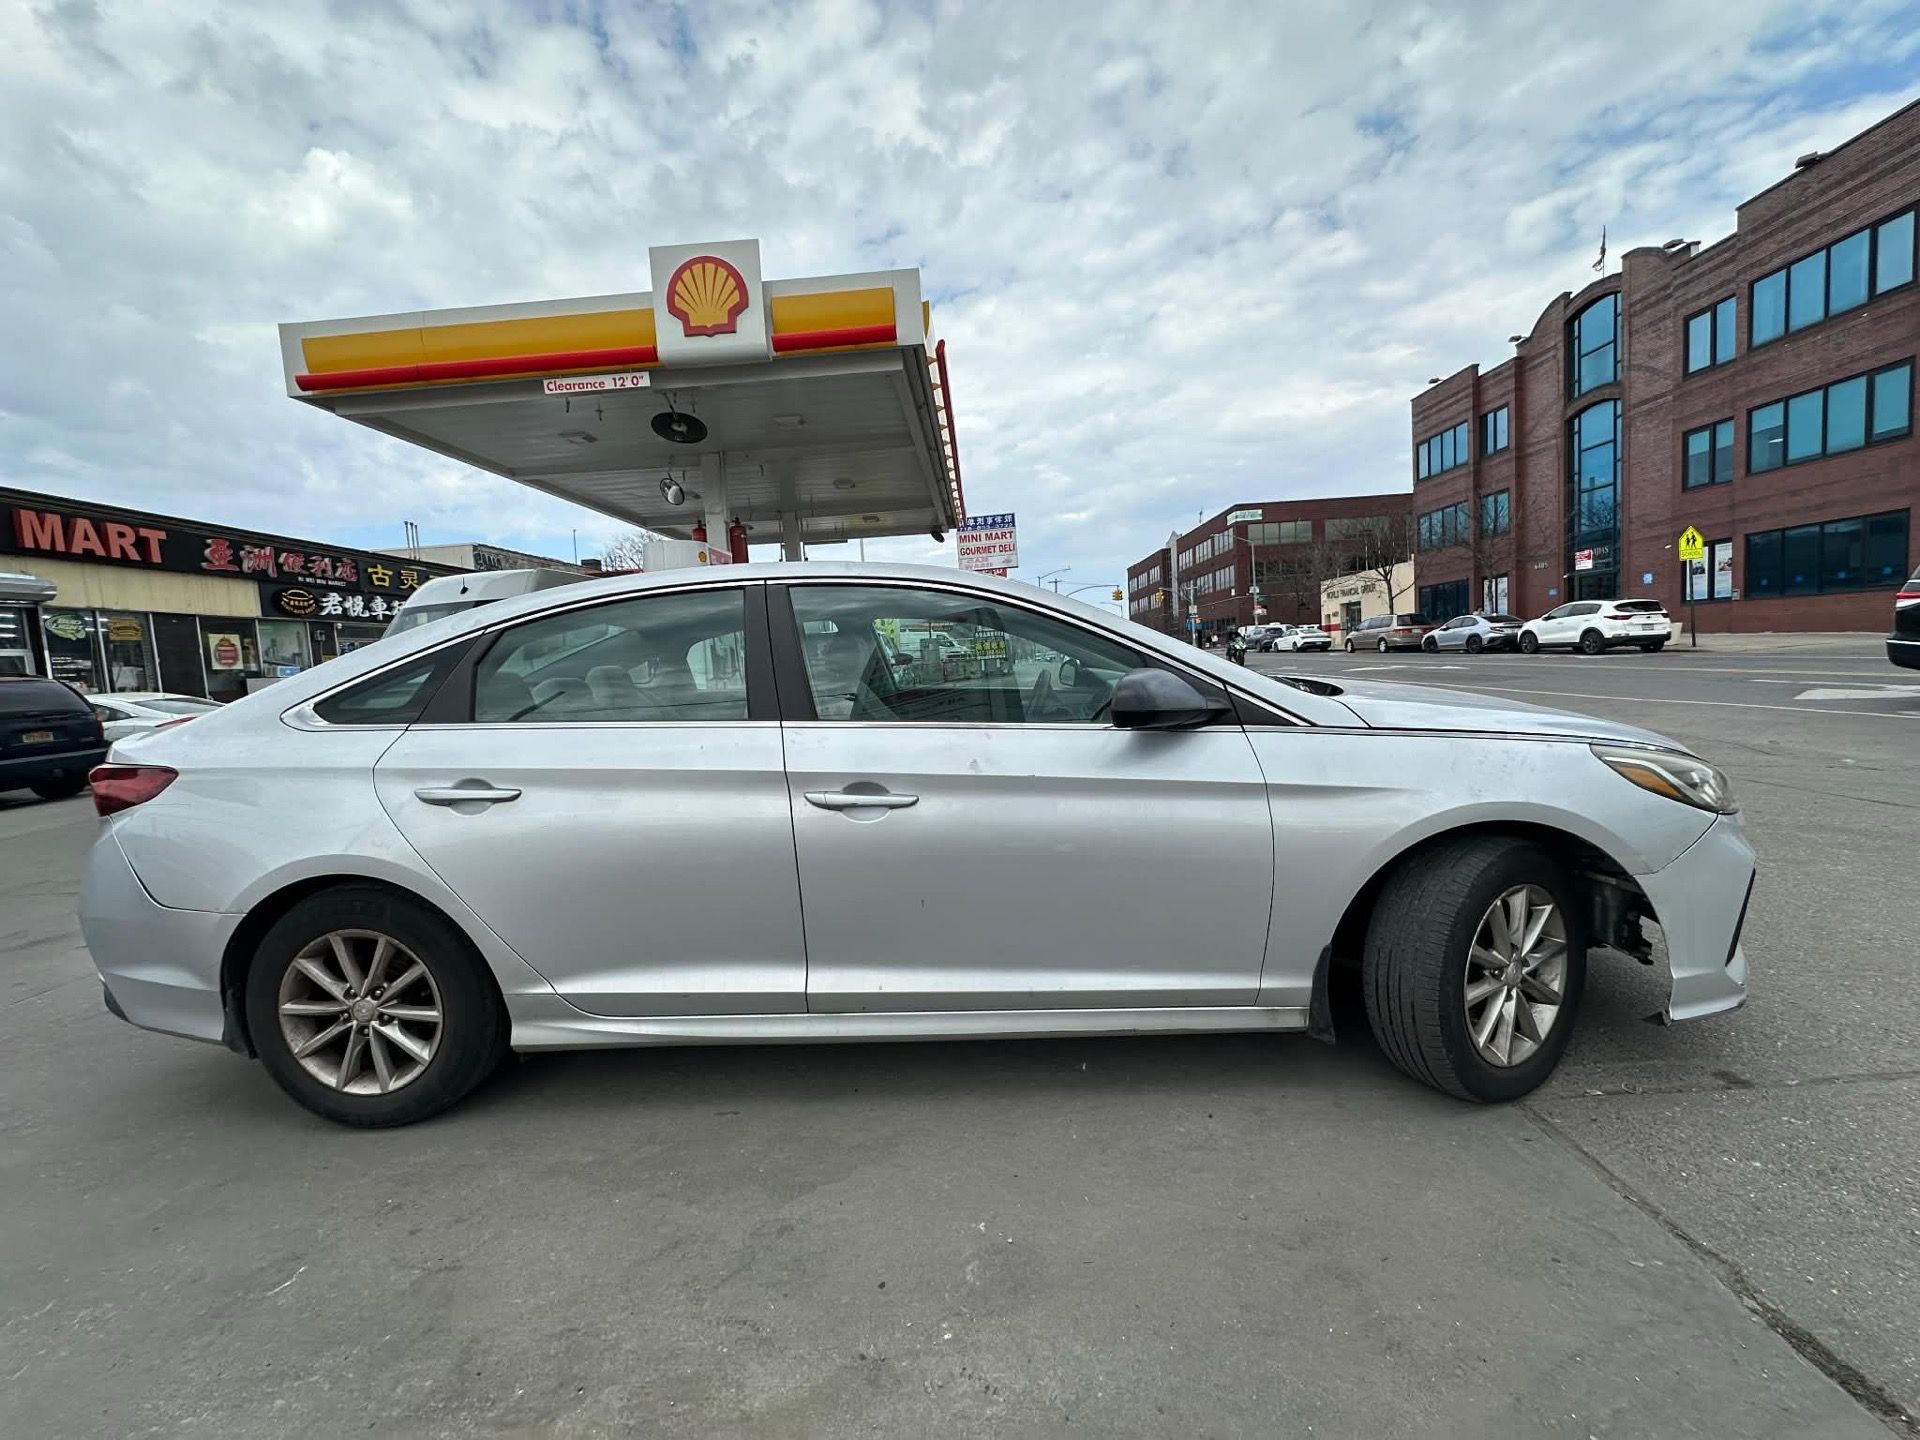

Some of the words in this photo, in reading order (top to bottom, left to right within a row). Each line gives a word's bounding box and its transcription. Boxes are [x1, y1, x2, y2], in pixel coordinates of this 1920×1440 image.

[546, 381, 606, 392] Clearance
[14, 508, 167, 563] MART
[960, 534, 982, 543] MINI
[985, 531, 1014, 541] MART
[960, 545, 996, 556] GOURMET
[998, 543, 1015, 553] DELI
[1681, 550, 1702, 558] SCHOOL
